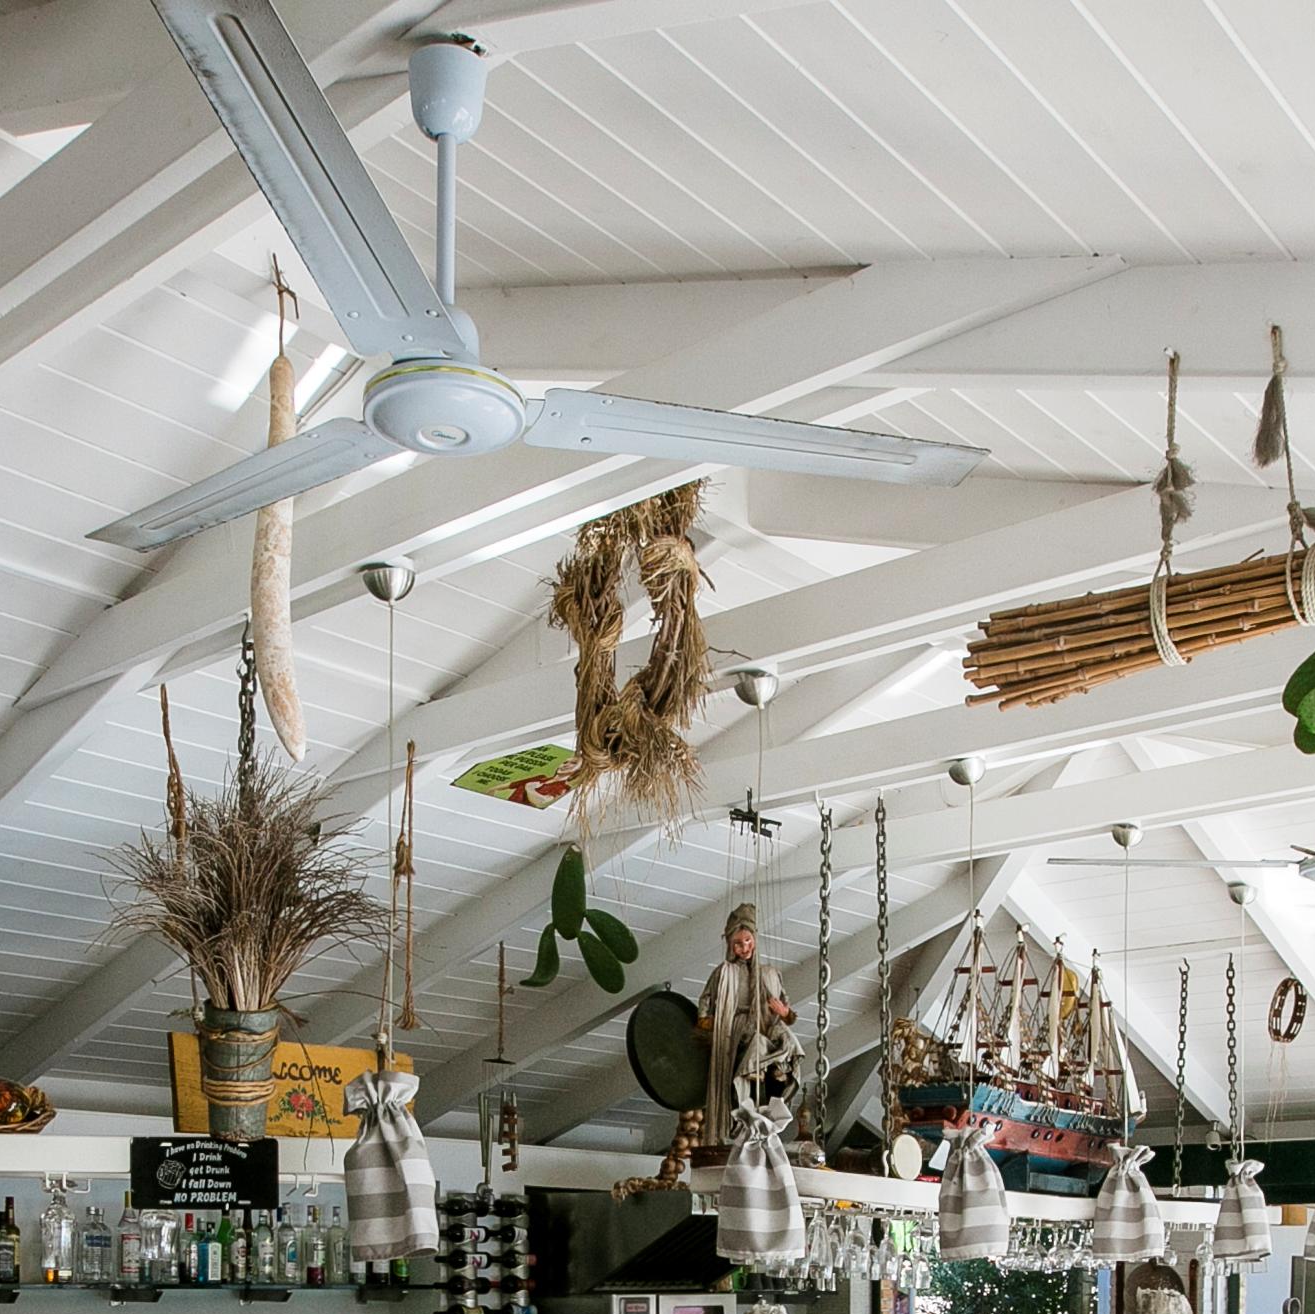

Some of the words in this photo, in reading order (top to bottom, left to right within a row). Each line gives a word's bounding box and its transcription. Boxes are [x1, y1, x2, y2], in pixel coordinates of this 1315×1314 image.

[170, 1144, 185, 1155] have
[199, 1152, 222, 1162] Drink
[188, 1167, 204, 1176] get
[205, 1165, 230, 1175] Drunk
[188, 1178, 205, 1188] fall
[207, 1179, 231, 1188] Down
[174, 1192, 189, 1202] NO
[190, 1191, 237, 1202] PROBLEM
